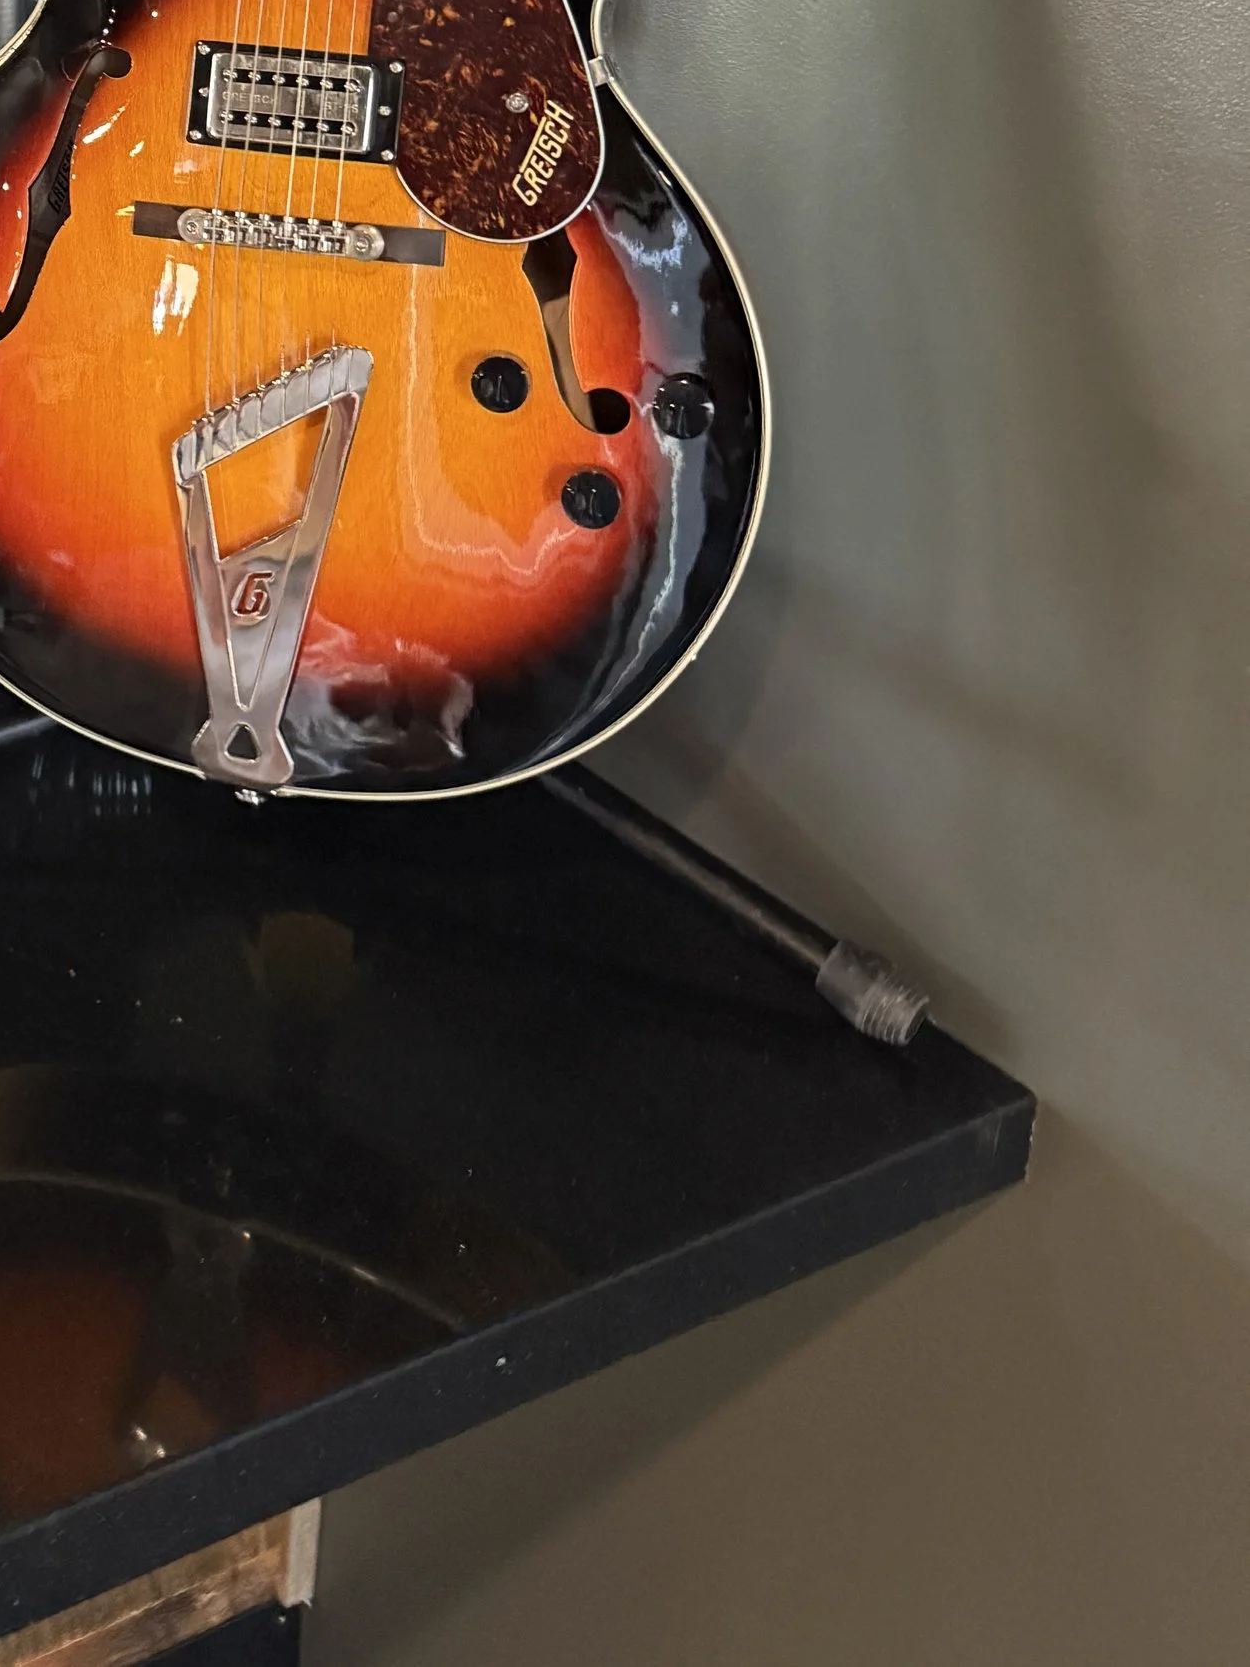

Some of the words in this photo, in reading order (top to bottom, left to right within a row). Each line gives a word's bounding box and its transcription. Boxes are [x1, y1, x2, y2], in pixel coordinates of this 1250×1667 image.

[222, 91, 277, 105] GRESCH
[512, 99, 574, 207] GRETSCH
[231, 571, 274, 617] G
